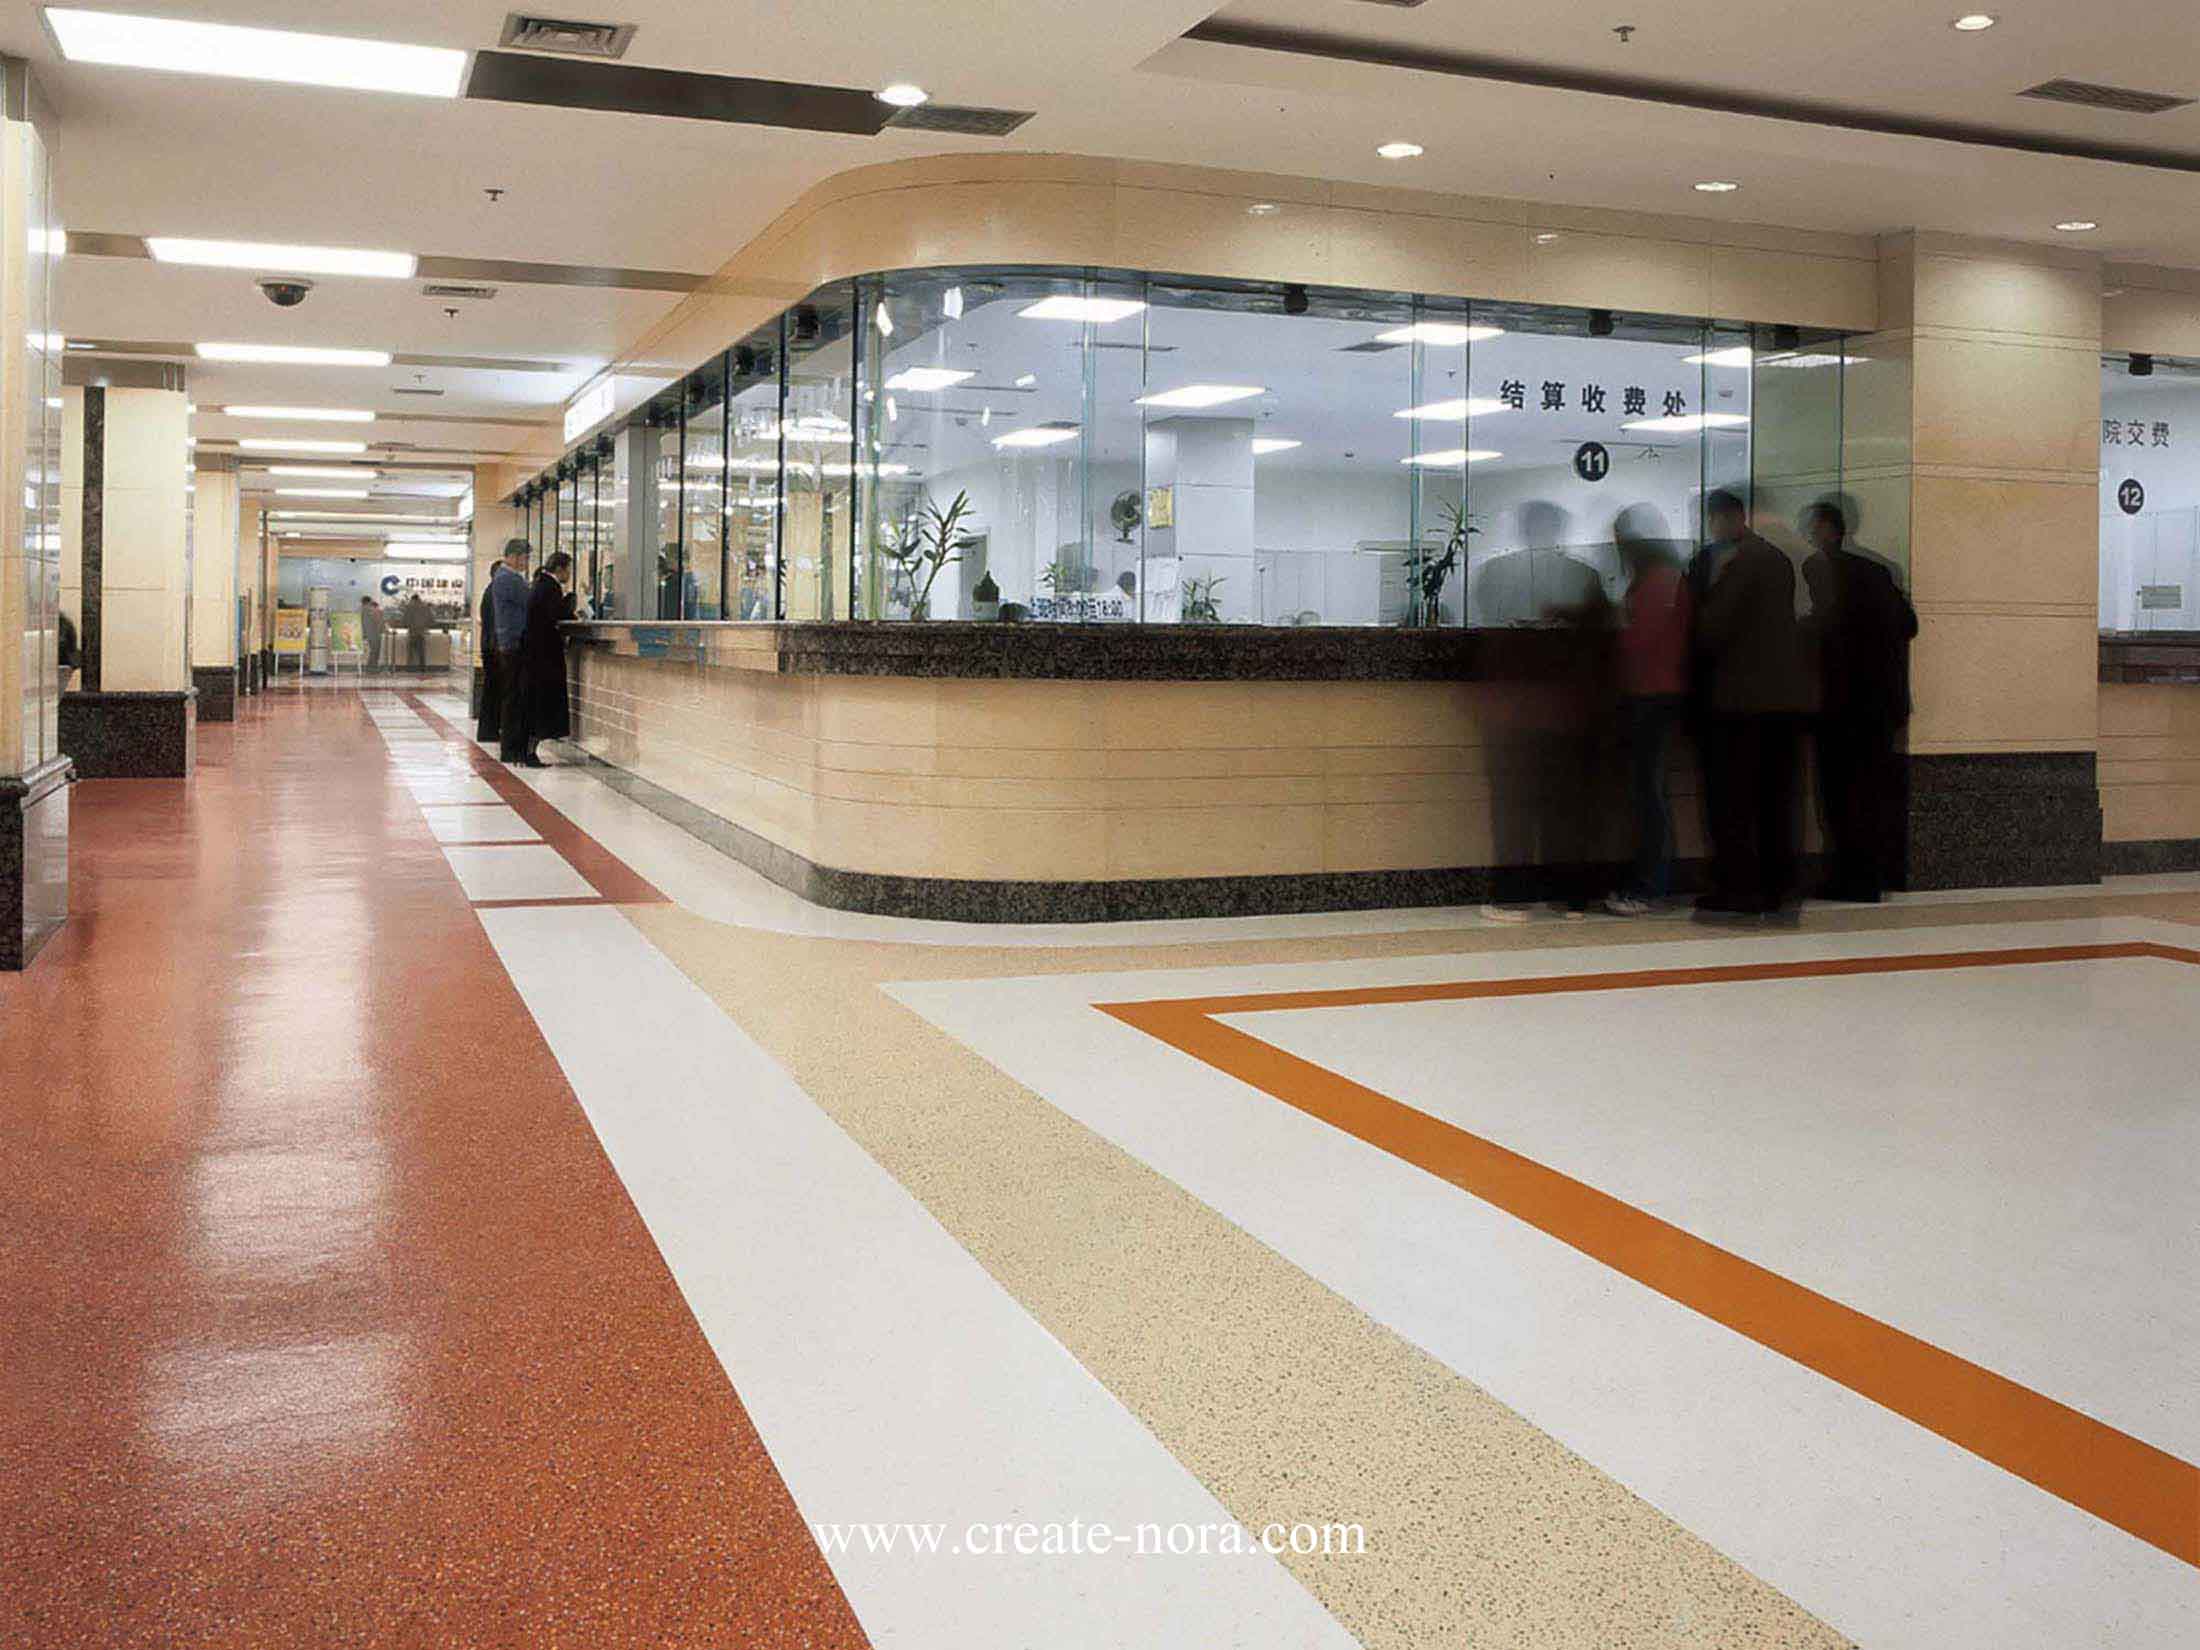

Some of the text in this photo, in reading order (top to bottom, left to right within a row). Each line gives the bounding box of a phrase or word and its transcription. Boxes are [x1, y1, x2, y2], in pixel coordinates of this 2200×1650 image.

[1500, 379, 1686, 417] 结算收费处
[1581, 450, 1605, 472] 11
[2120, 487, 2141, 506] 12
